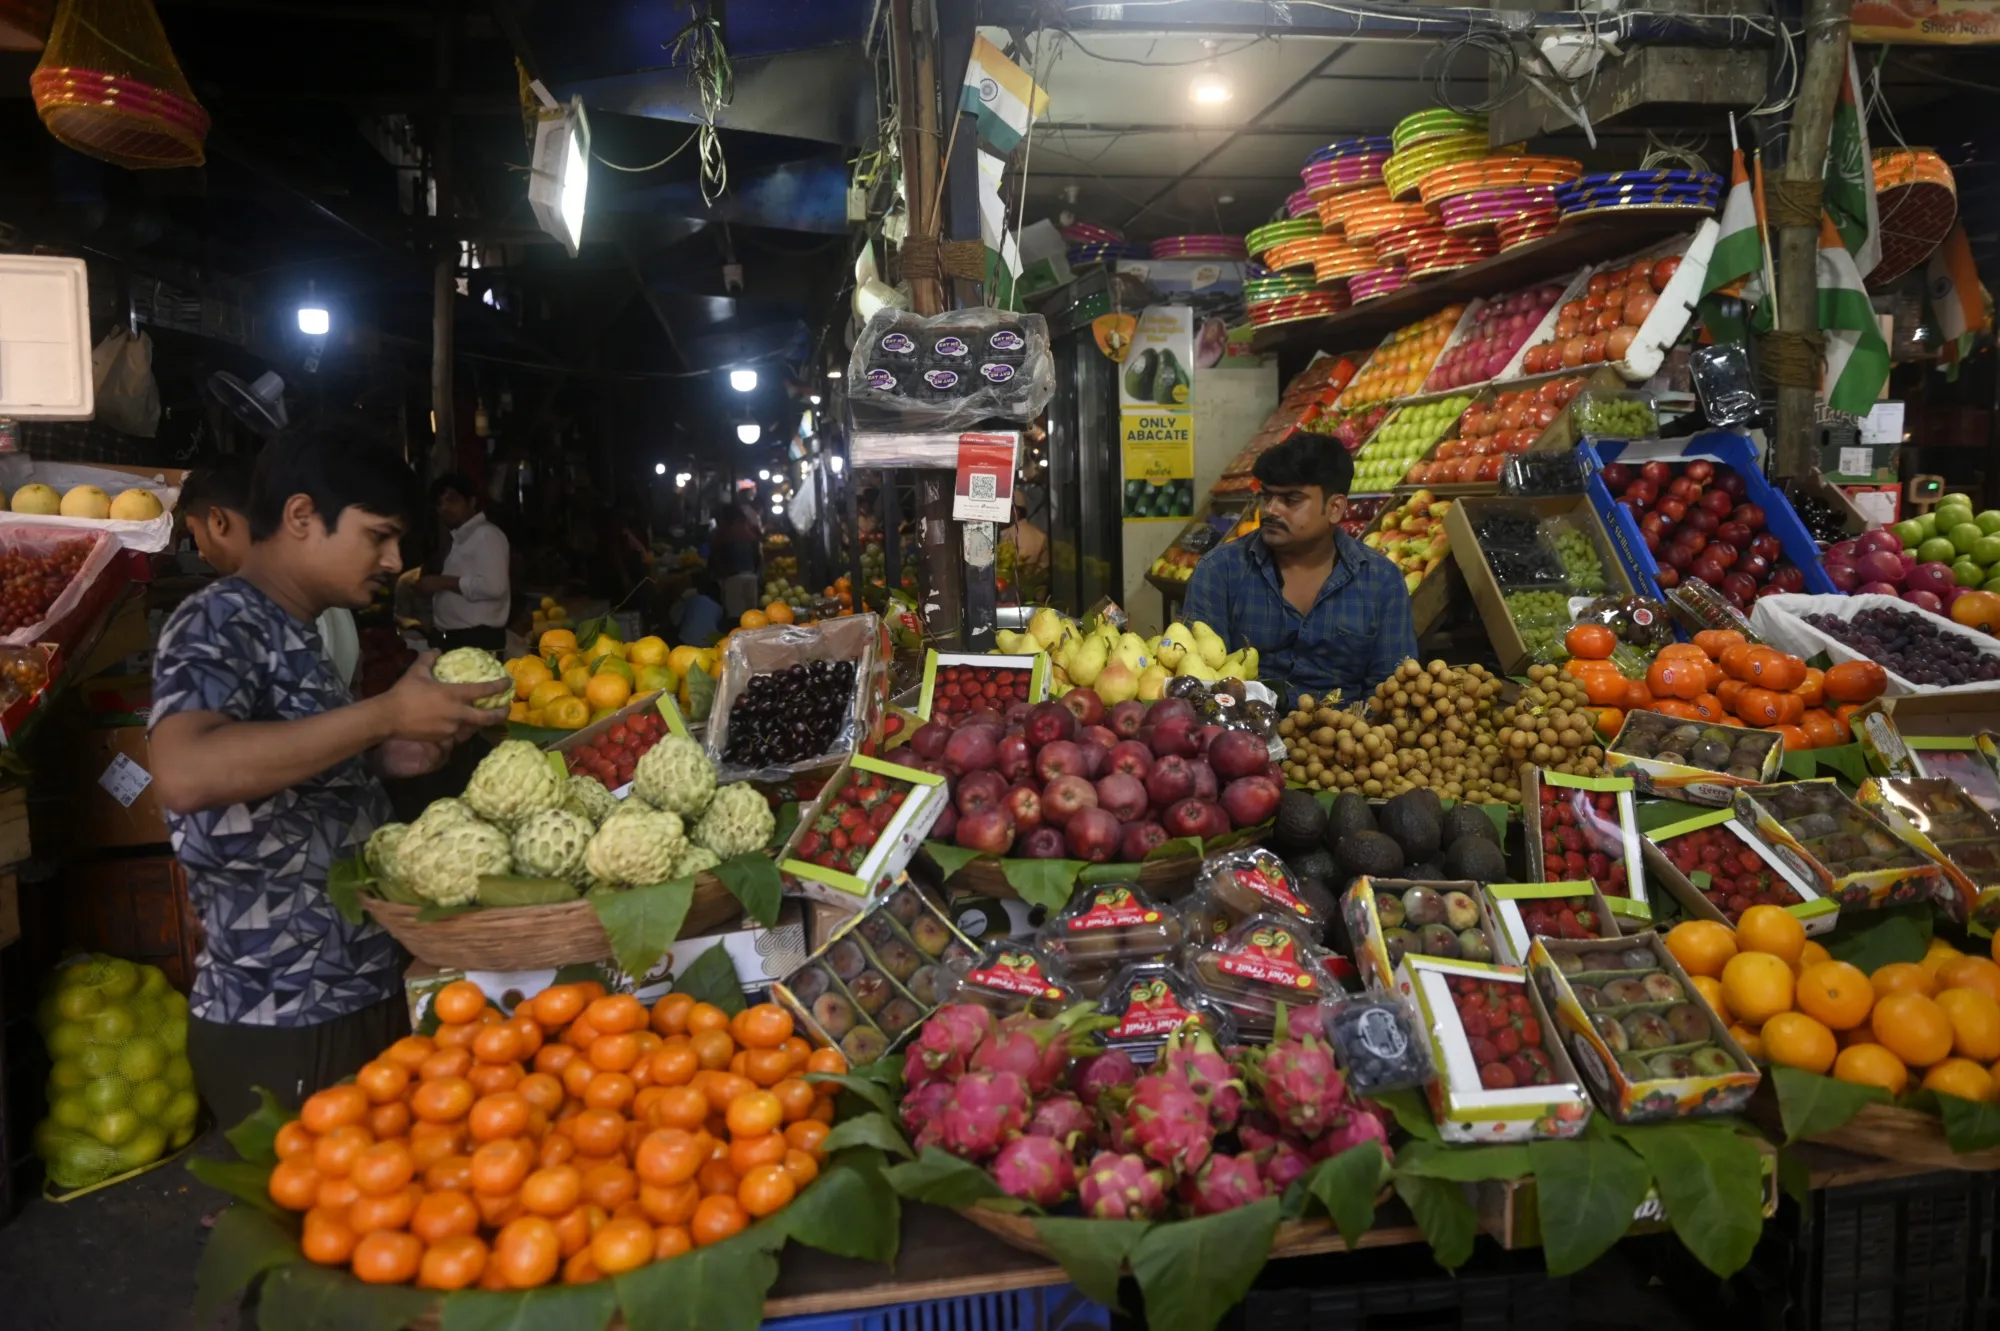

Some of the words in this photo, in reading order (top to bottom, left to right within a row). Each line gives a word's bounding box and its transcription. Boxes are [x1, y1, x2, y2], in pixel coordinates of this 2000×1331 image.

[1922, 20, 1955, 35] Shop
[1139, 417, 1176, 428] ONLY
[1127, 429, 1188, 441] ABACATE
[1086, 918, 1114, 928] Fruit
[1117, 916, 1143, 924] Kiwi
[1236, 963, 1265, 978] Fruit
[1266, 969, 1295, 985] Kiwi
[987, 976, 1016, 990] Fruit
[1018, 983, 1043, 996] Kiwi
[1125, 1022, 1155, 1035] Fruit
[1157, 1019, 1183, 1032] Kiwi
